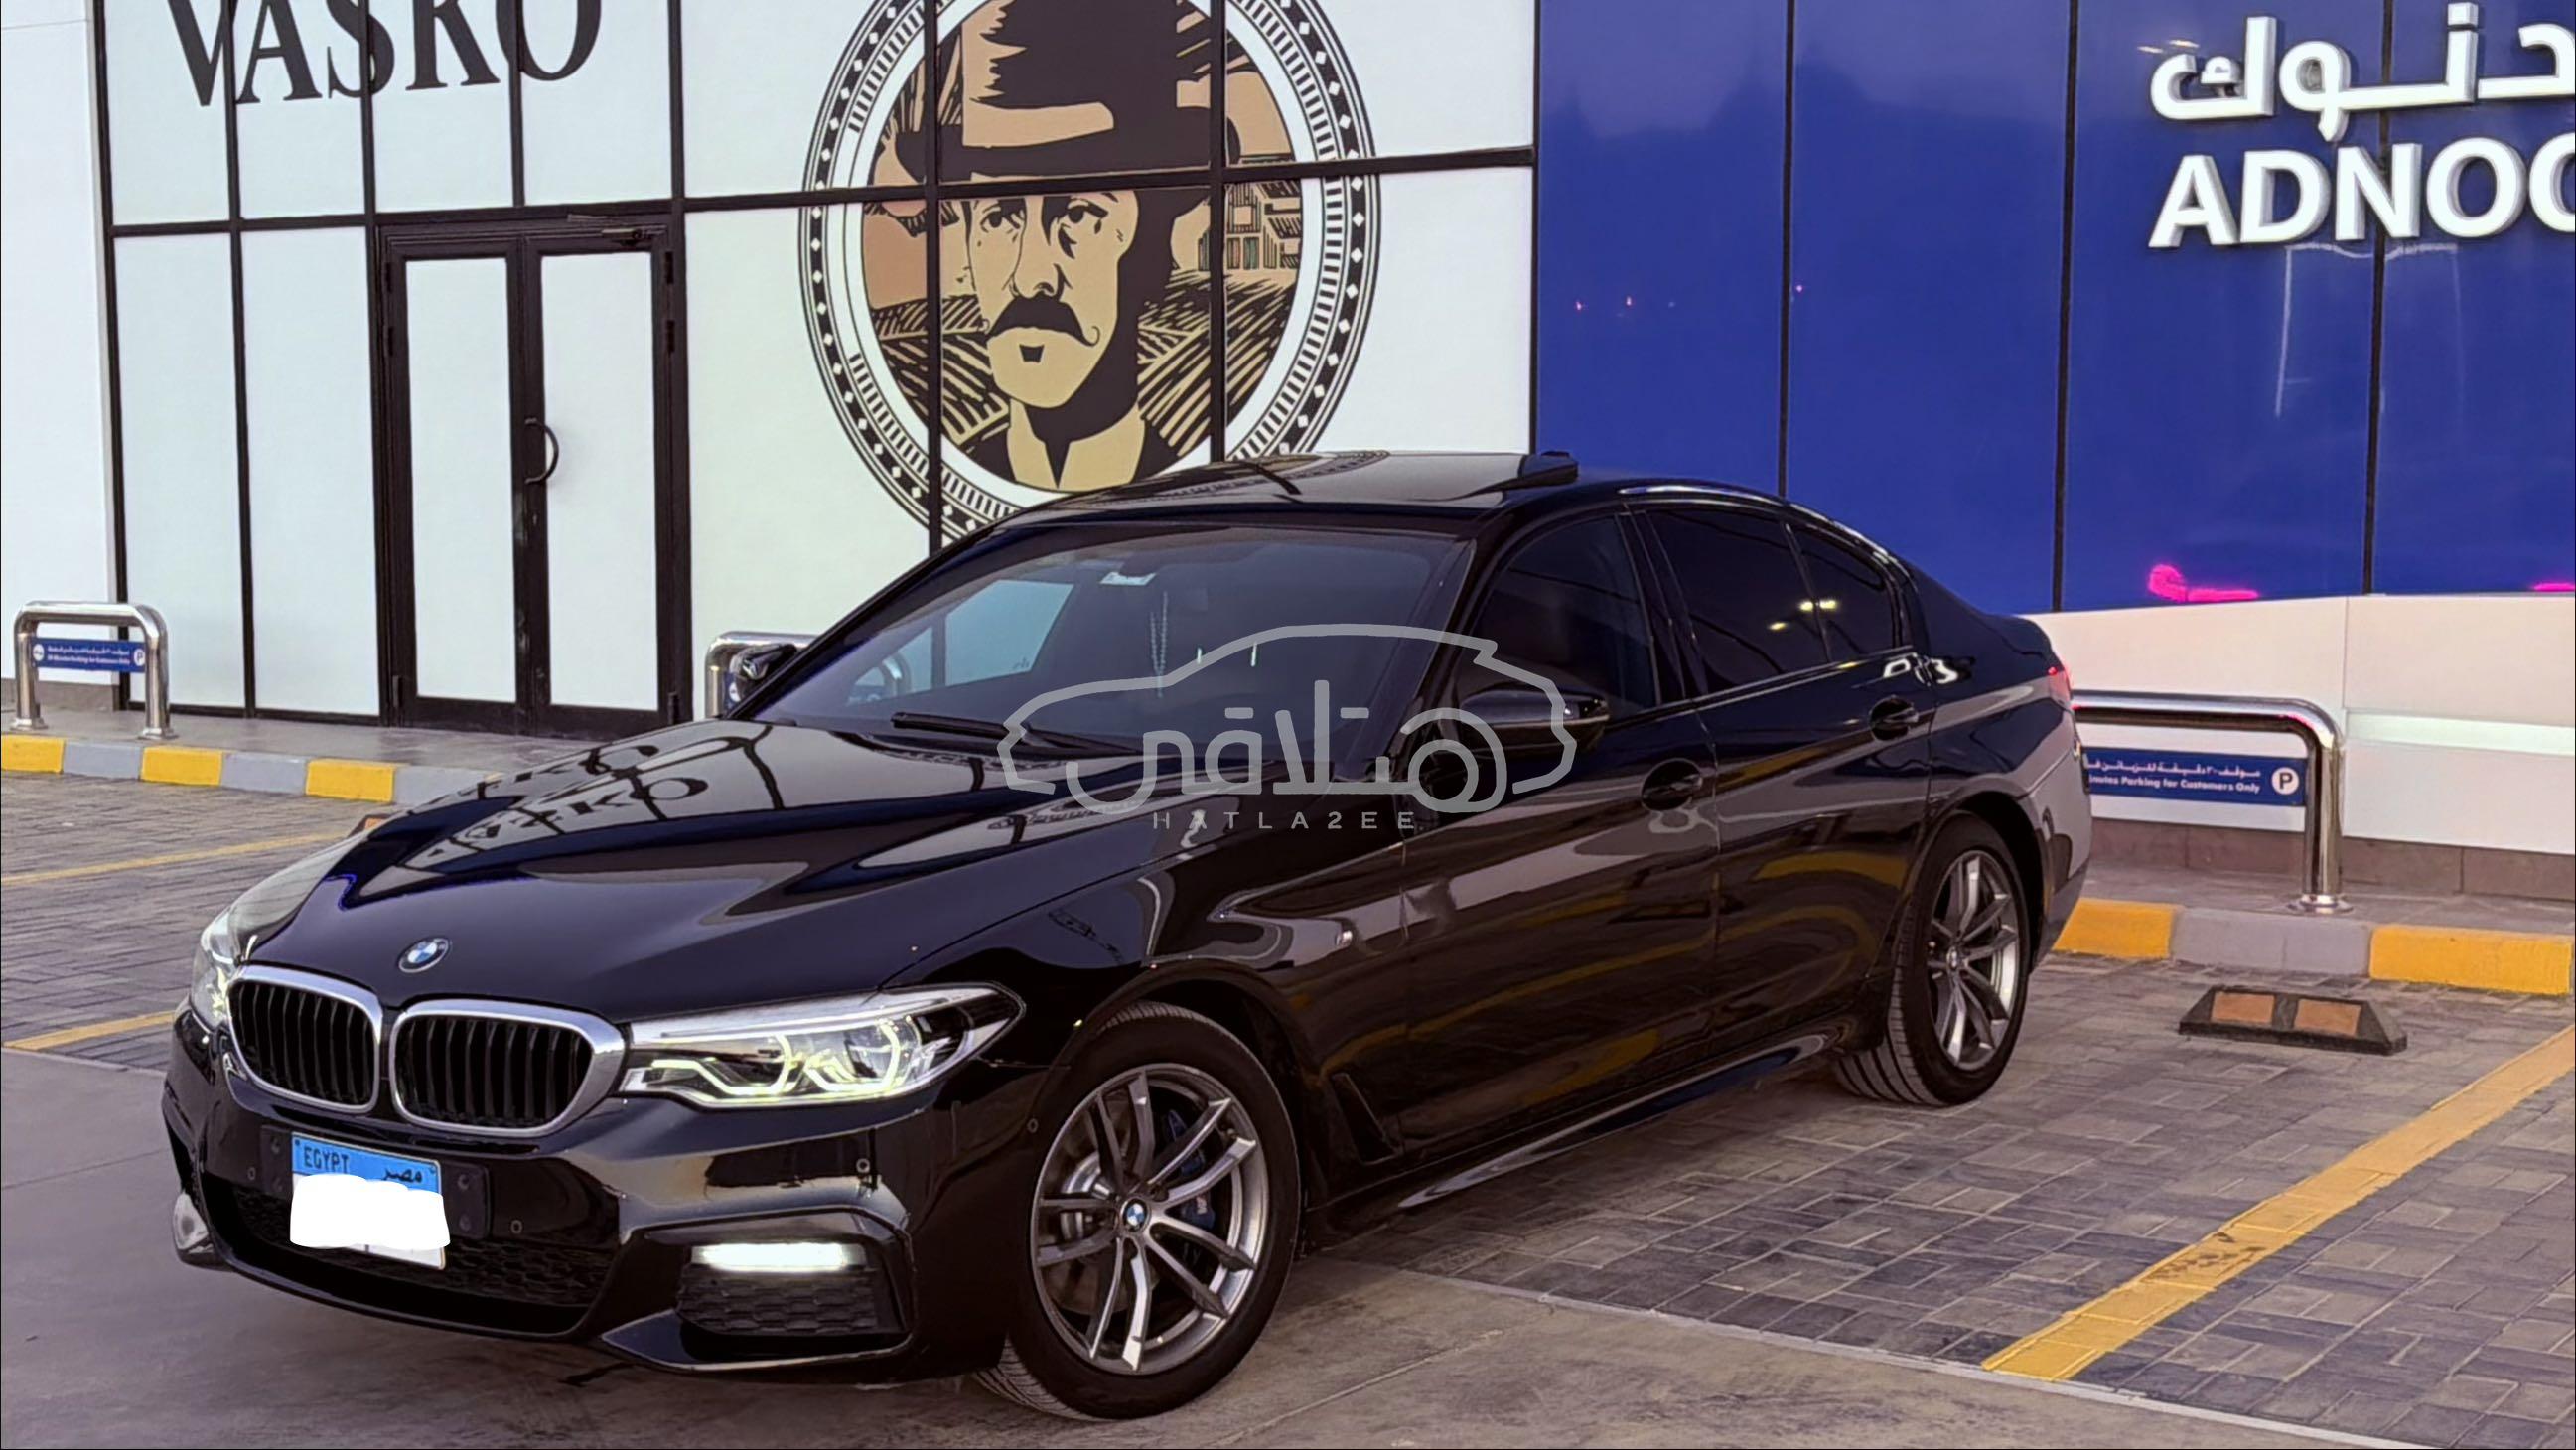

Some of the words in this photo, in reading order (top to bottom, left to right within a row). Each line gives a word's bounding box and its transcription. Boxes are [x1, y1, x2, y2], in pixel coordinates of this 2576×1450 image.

[2121, 775, 2160, 789] Parking
[2163, 778, 2179, 787] for
[2180, 778, 2234, 792] Customers
[2235, 782, 2260, 795] Only
[304, 1146, 349, 1175] EGYPT
[383, 1167, 423, 1184] مصر
